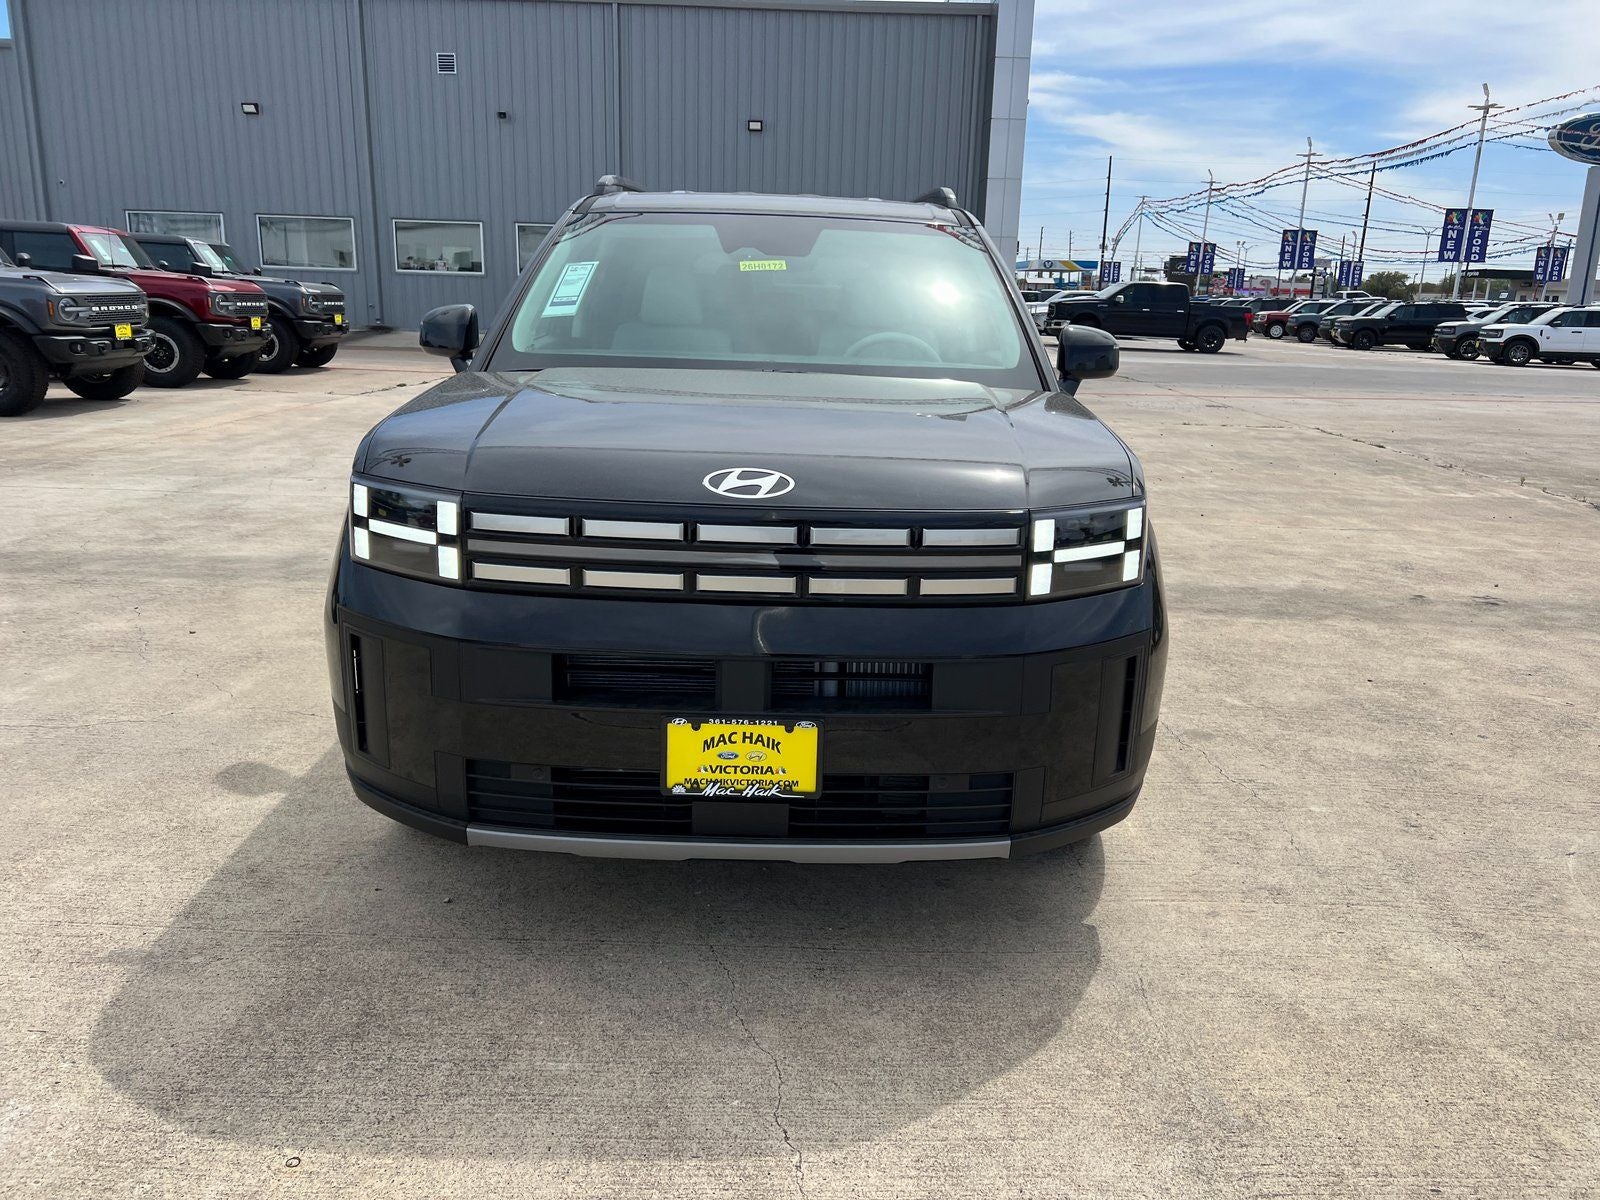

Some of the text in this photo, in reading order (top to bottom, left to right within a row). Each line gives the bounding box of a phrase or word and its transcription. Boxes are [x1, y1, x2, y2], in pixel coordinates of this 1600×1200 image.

[1443, 229, 1458, 260] NEW
[1470, 230, 1483, 261] FORD
[1188, 254, 1197, 273] NEW
[1282, 245, 1292, 268] NEW
[1301, 245, 1310, 269] FORD
[1536, 260, 1545, 280] NEW
[1552, 260, 1560, 281] FORD
[702, 731, 782, 755] MAC HAIK
[708, 764, 775, 775] VICTORIA
[701, 781, 785, 798] Mac Haik
